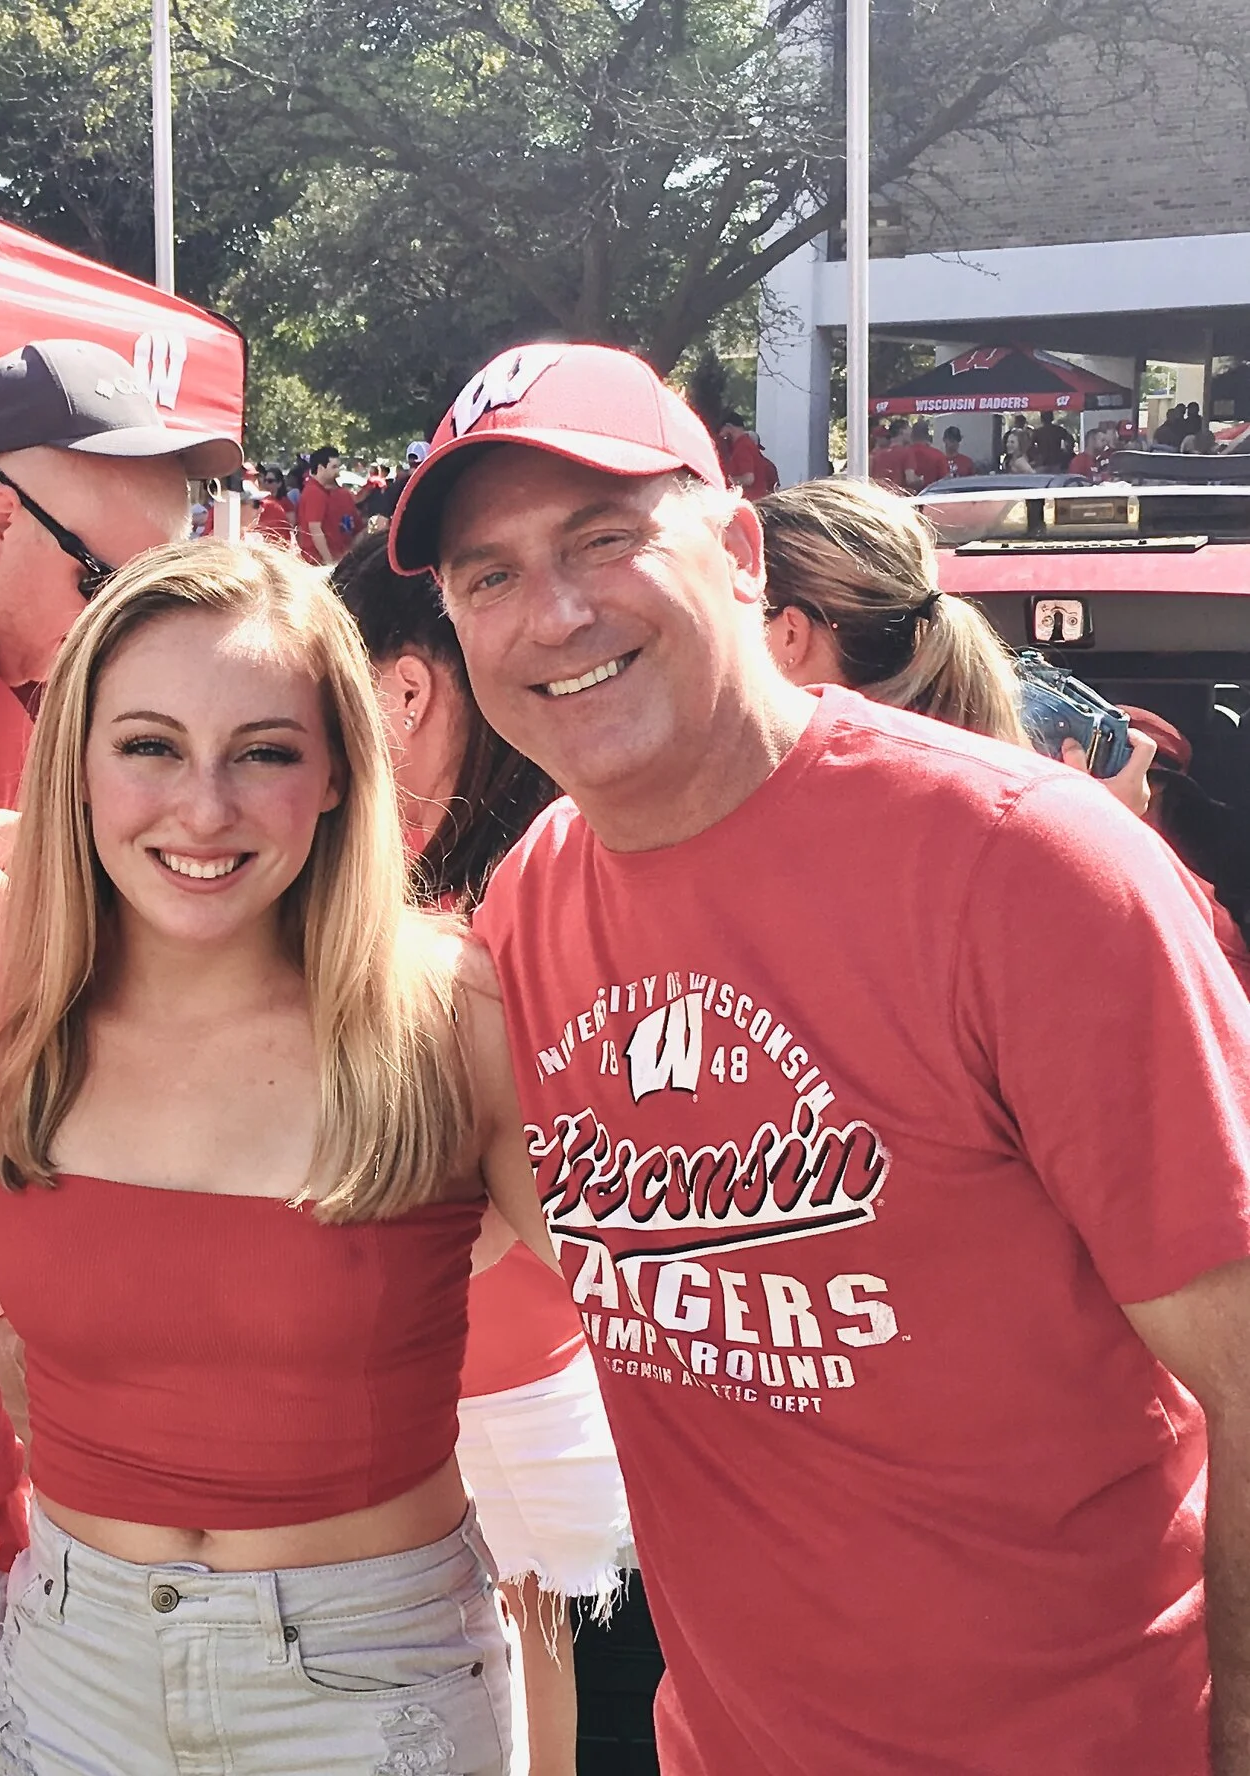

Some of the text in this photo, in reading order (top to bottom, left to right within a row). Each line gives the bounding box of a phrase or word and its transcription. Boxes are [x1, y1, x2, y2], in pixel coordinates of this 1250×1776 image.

[915, 397, 1029, 412] WISCONSIN BADGERS
[599, 992, 749, 1103] 18 W 48
[689, 971, 836, 1112] WISCONSIN
[770, 1395, 822, 1413] DEPT
